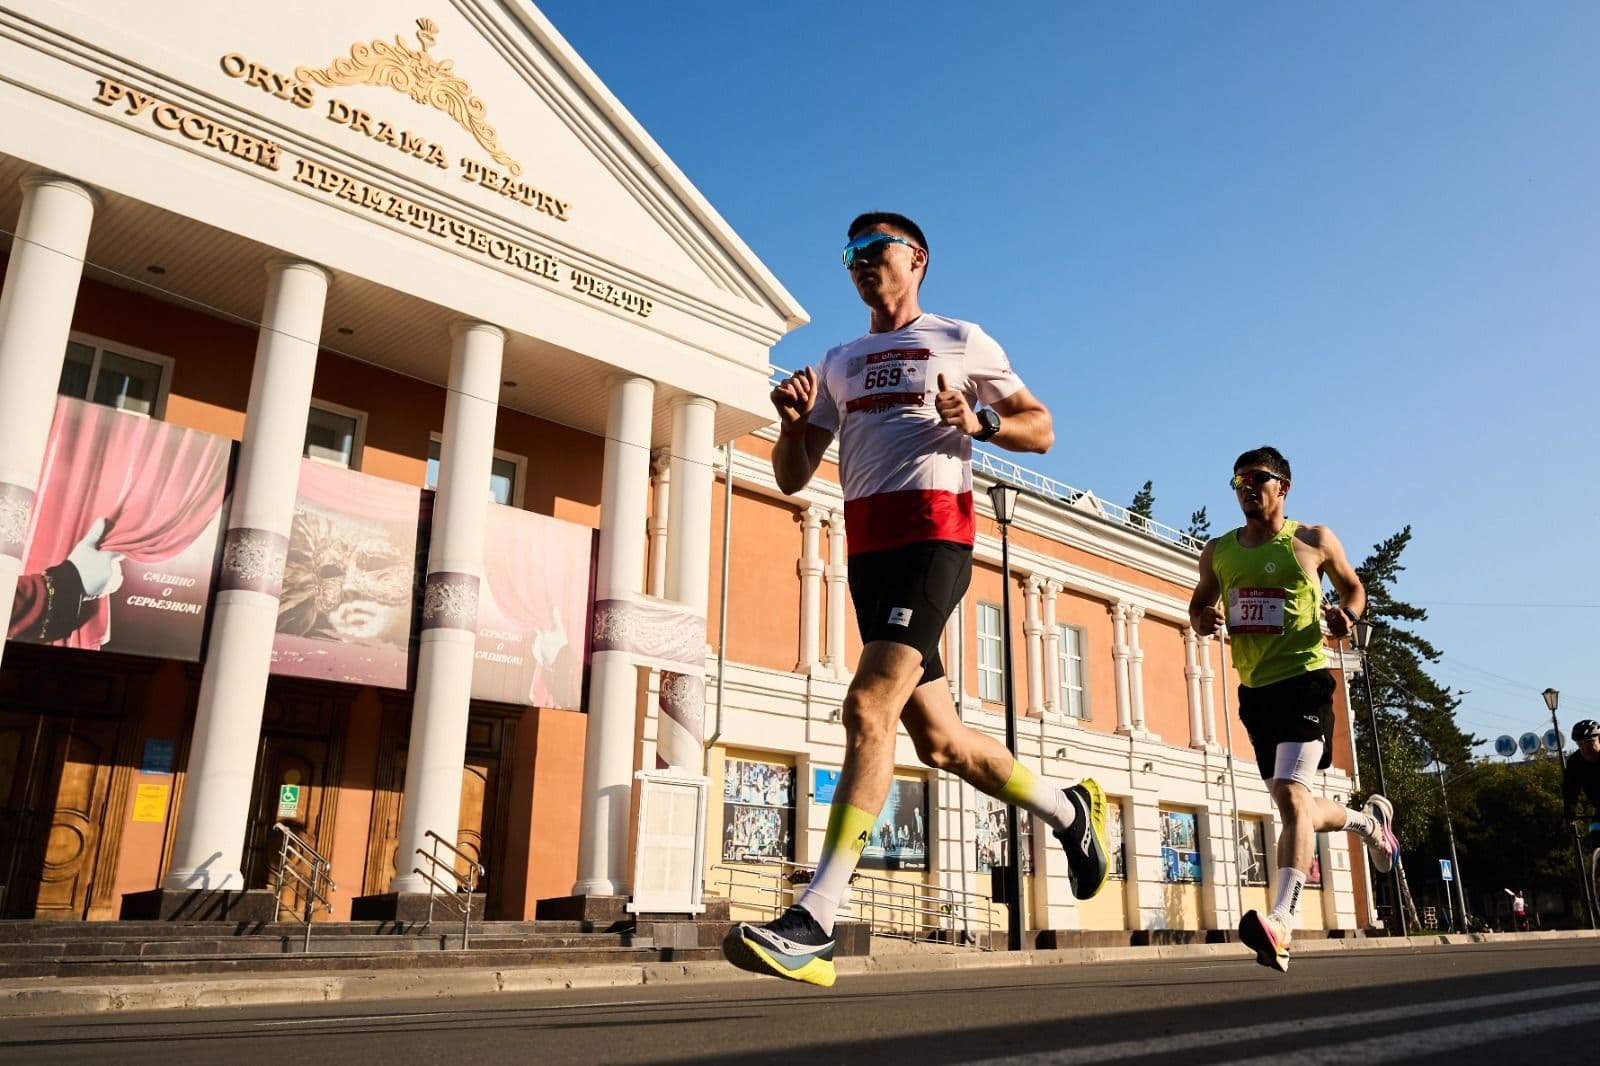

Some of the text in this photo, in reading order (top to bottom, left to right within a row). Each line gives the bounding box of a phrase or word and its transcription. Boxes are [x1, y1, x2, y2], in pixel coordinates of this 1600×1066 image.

[220, 52, 573, 222] ORYS DRAMA TEATRY
[92, 78, 654, 318] РУССКИЙ ДРАМАТИЧЕСКИЙ ТЕАТР
[865, 367, 902, 390] 669
[143, 572, 195, 587] СМЕШНО
[162, 587, 172, 597] О
[126, 595, 202, 614] СЕРЬЕЗНОМ!
[1240, 604, 1264, 621] 371
